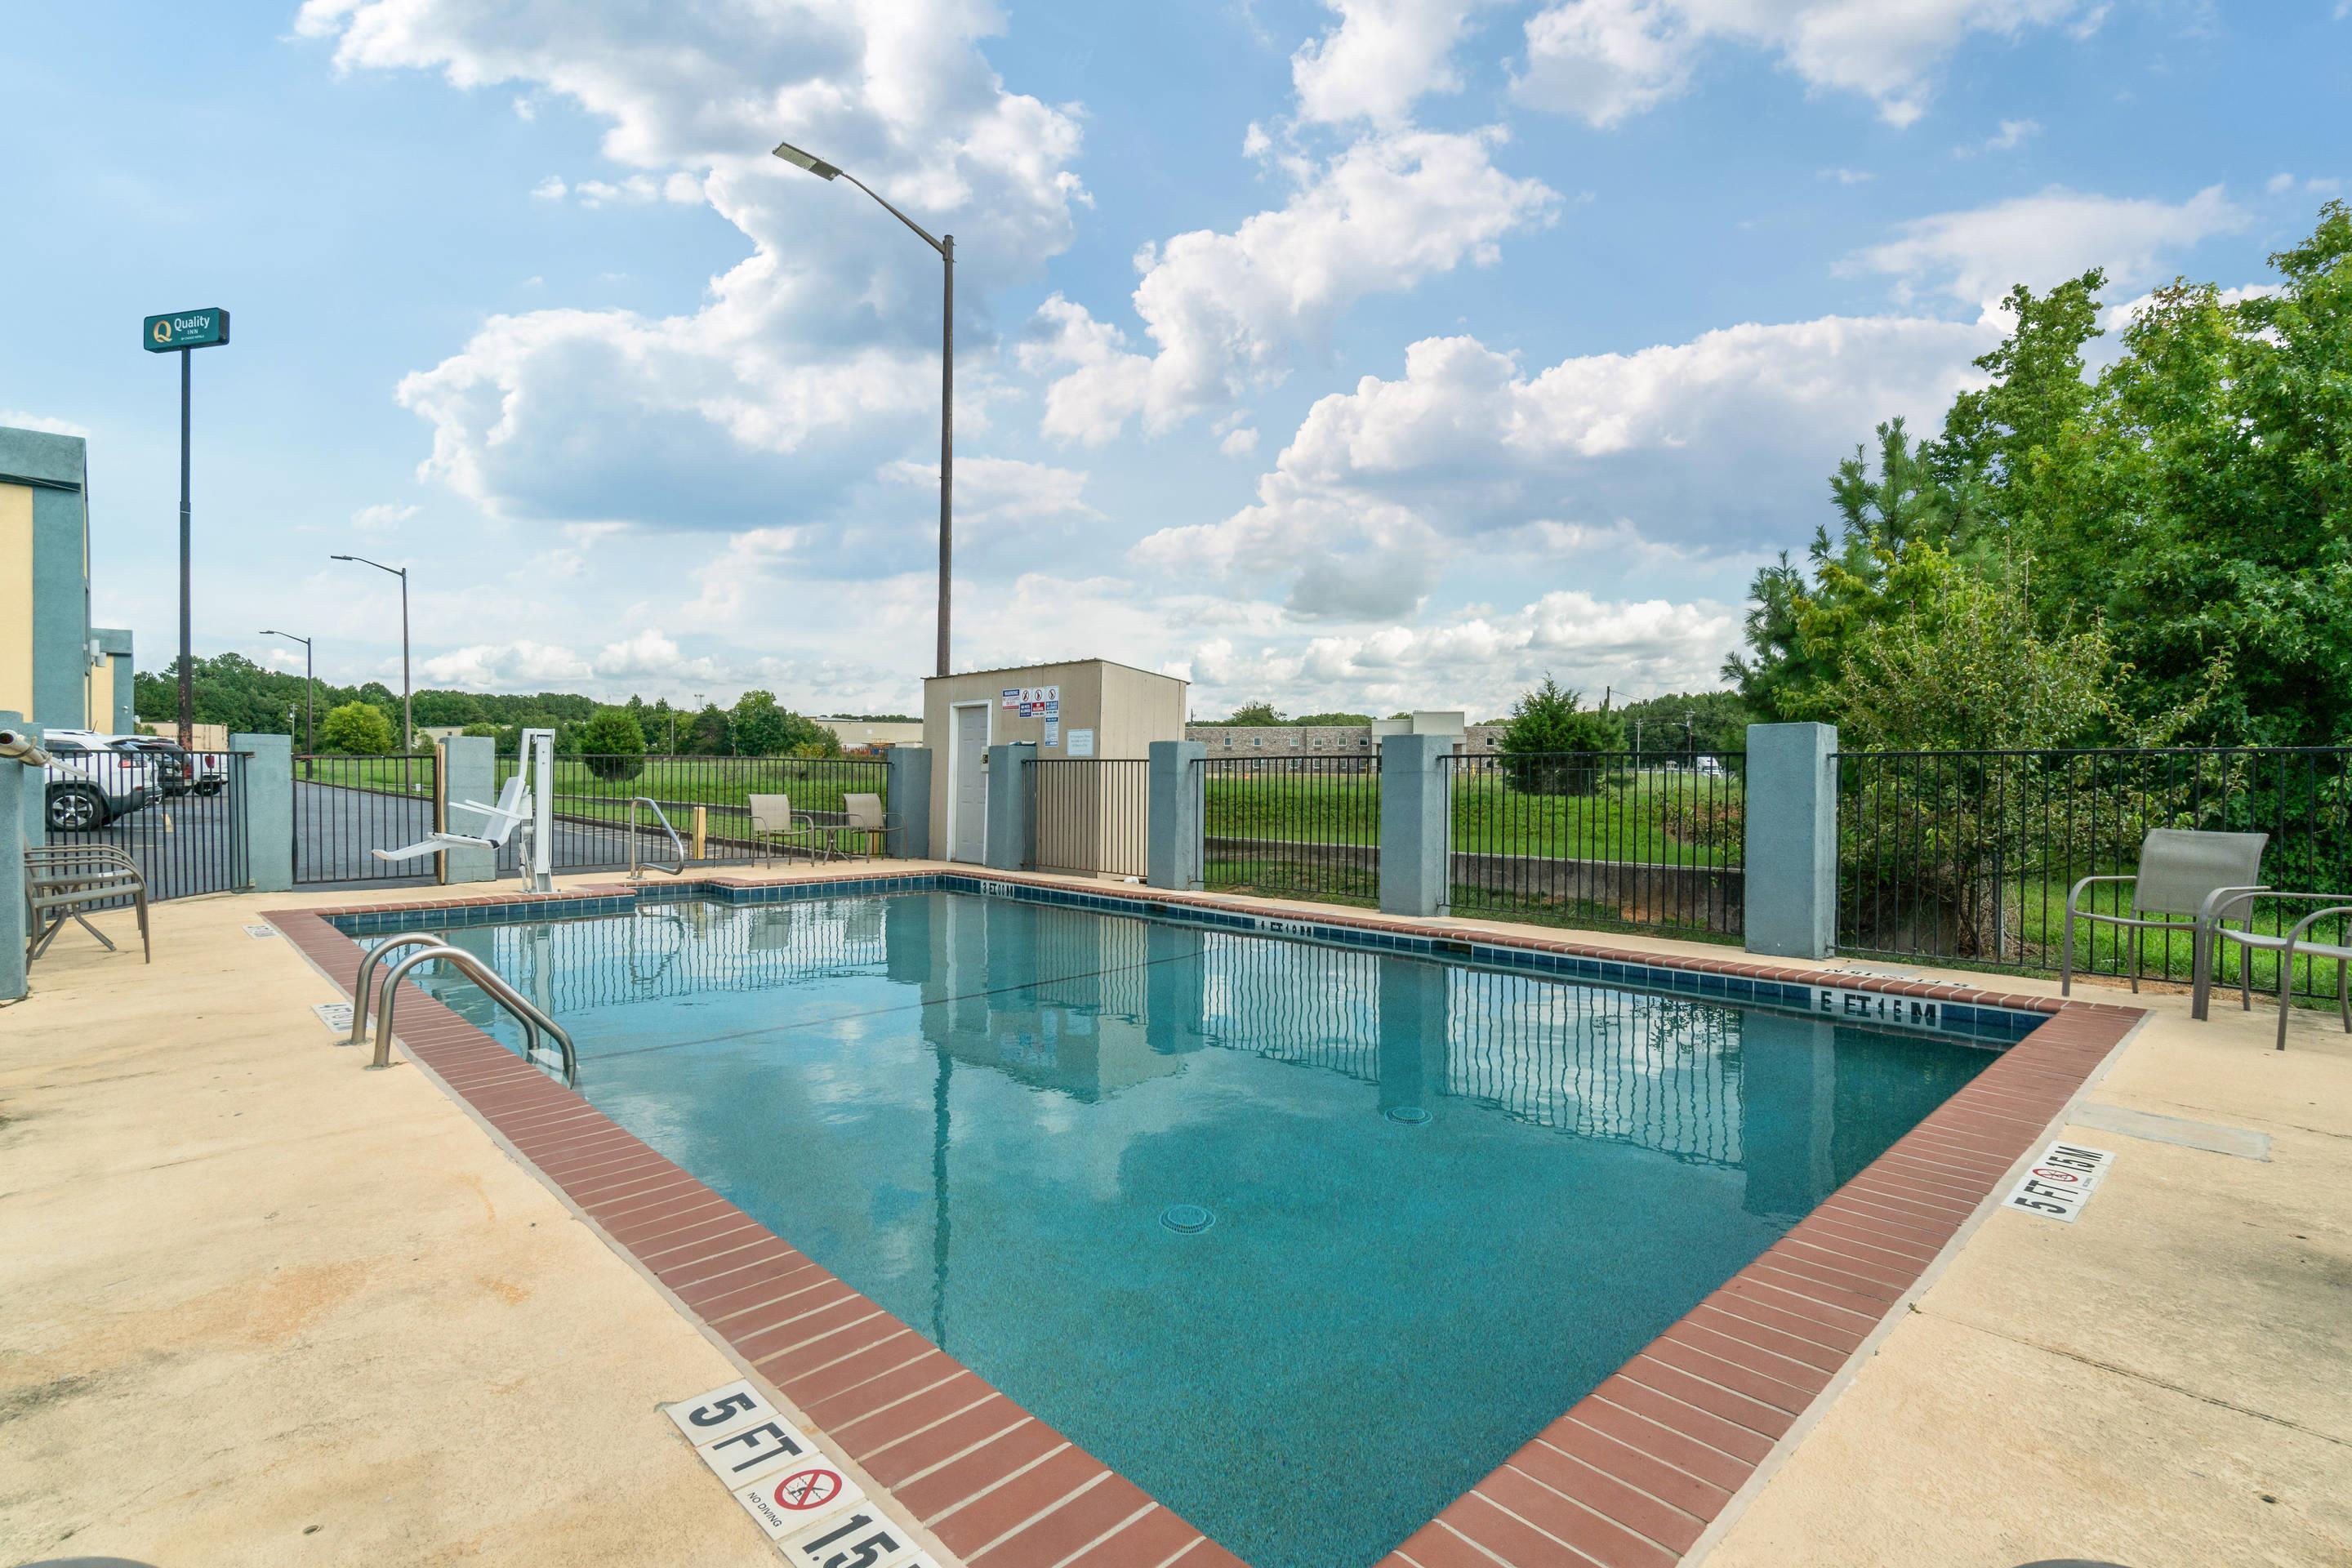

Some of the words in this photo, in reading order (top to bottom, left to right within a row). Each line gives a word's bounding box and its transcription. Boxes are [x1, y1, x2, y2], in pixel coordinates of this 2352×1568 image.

[174, 315, 210, 332] Quality
[2055, 1146, 2104, 1162] M
[2024, 1179, 2078, 1203] FT
[2014, 1196, 2067, 1214] 5
[688, 1392, 757, 1428] 5
[712, 1422, 804, 1473] FT
[746, 1492, 761, 1503] NO
[757, 1503, 782, 1527] DIVING
